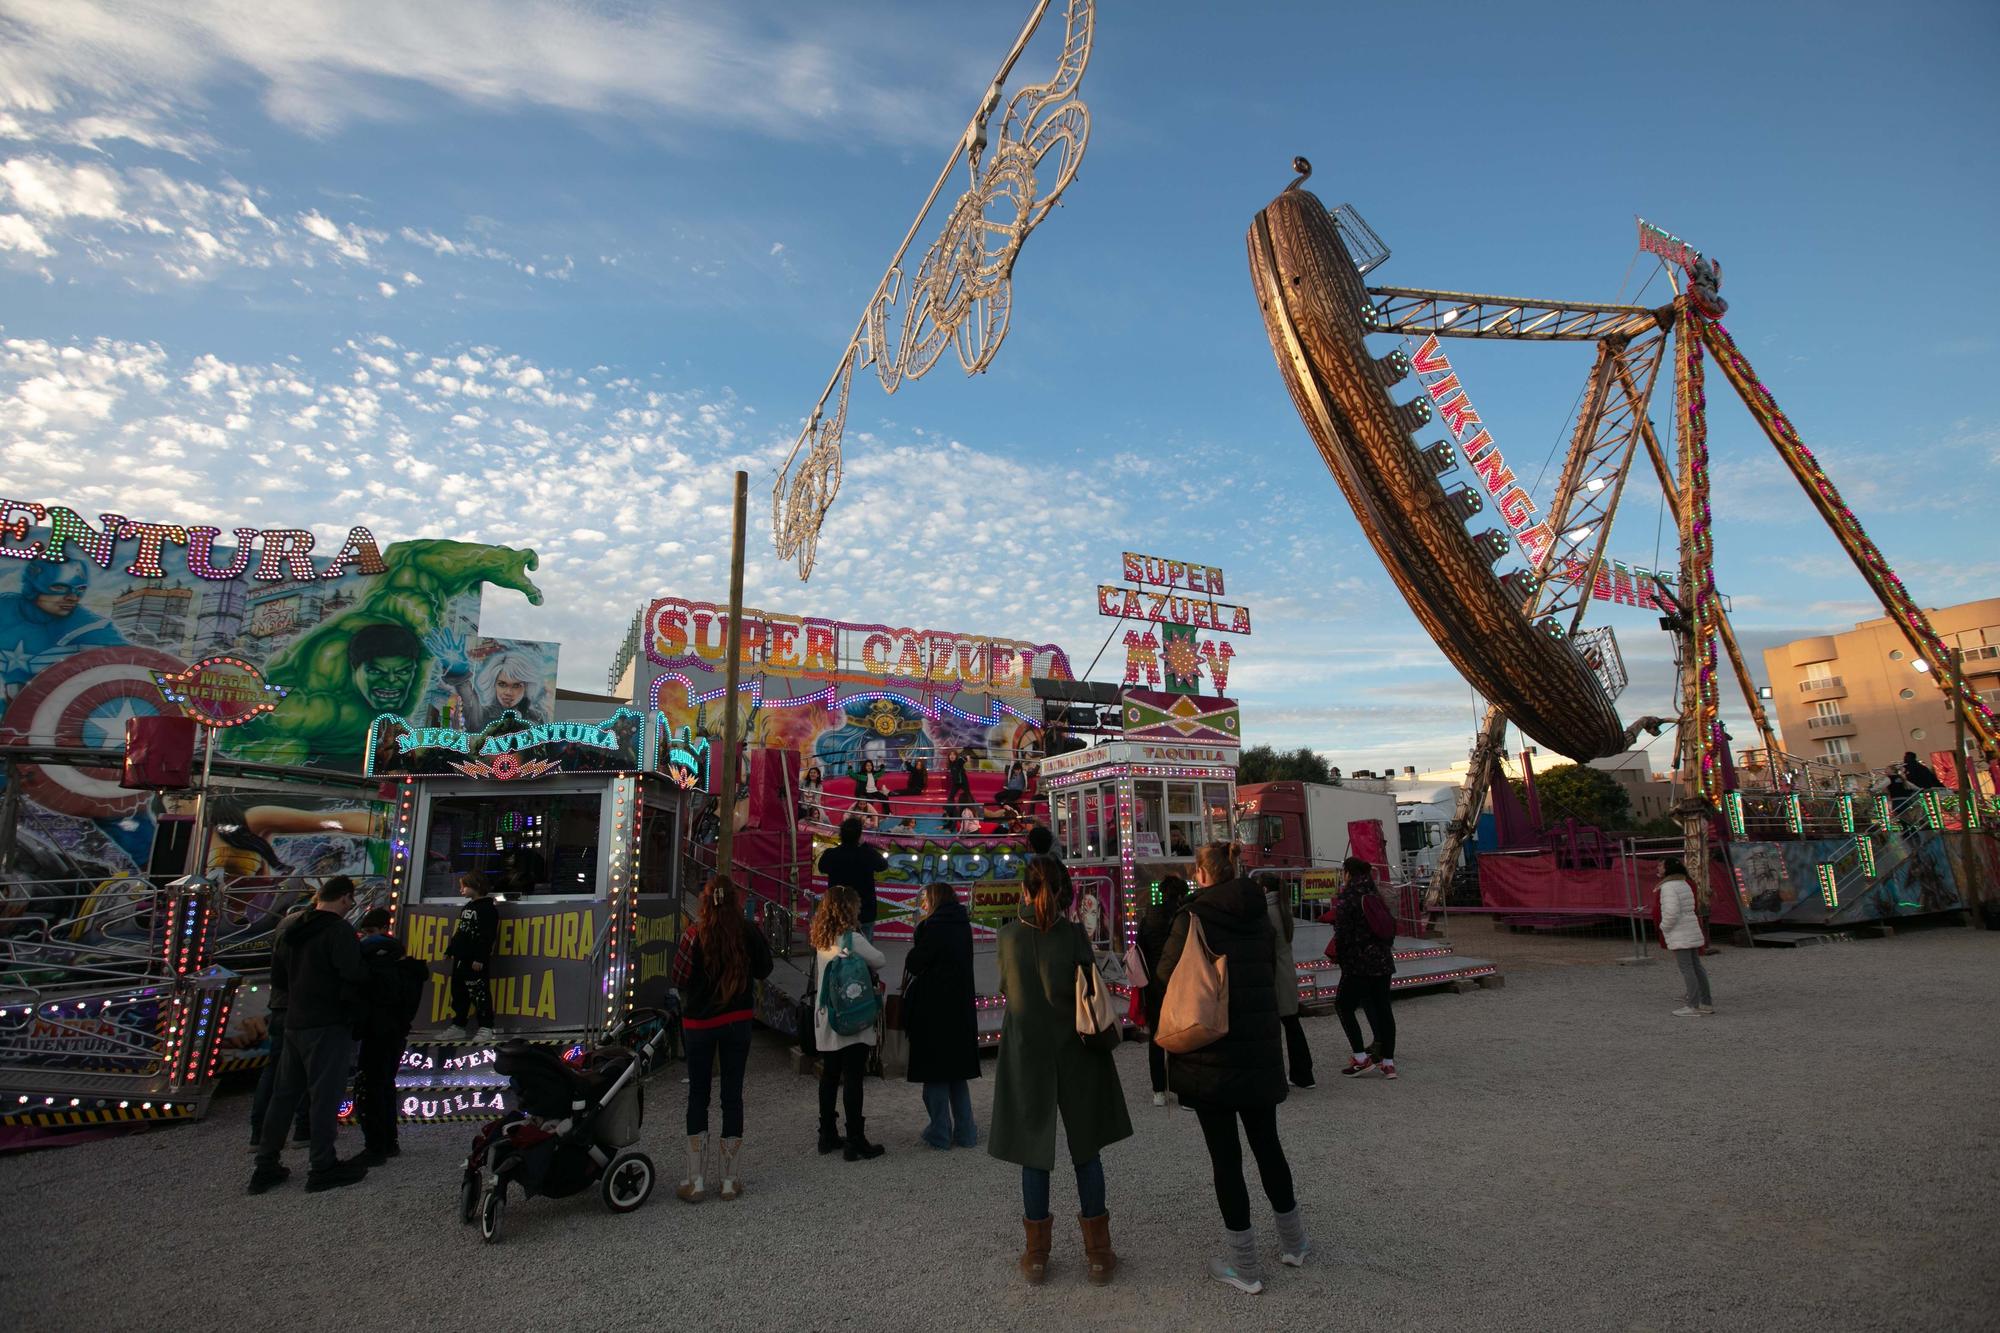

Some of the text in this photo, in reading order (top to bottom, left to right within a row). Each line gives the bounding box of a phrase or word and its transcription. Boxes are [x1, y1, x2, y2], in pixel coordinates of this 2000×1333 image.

[1410, 332, 1556, 570] VIKINGA
[1122, 552, 1225, 596] SUPER
[1099, 585, 1250, 634] CAZUELA
[656, 609, 838, 672] SUPER
[174, 683, 271, 703] AVENTURA
[199, 671, 252, 690] MEGA
[398, 724, 619, 756] MEGA AVENTURA
[1143, 747, 1226, 762] TAQUILLA
[976, 892, 1023, 906] SALIDA
[406, 909, 596, 962] MEG ENTURA
[432, 968, 557, 1023] TAILLA
[29, 1019, 116, 1038] MEGA
[6, 1037, 130, 1057] AVENTURA
[402, 1090, 506, 1118] QUILLA
